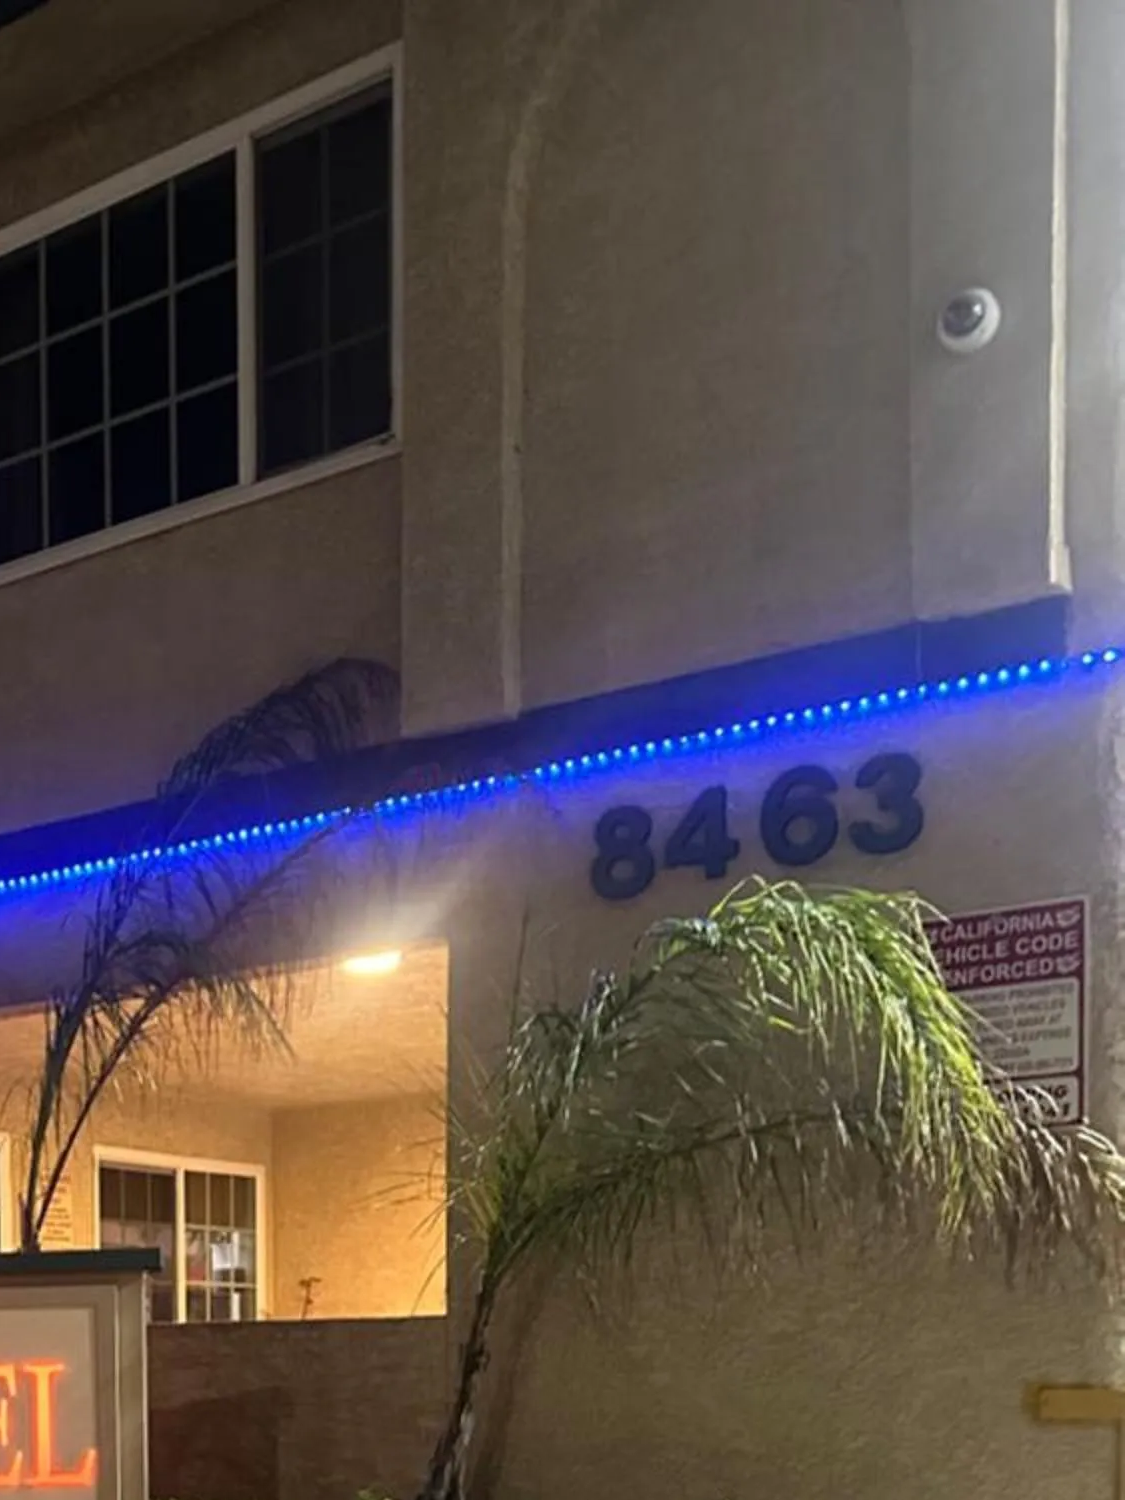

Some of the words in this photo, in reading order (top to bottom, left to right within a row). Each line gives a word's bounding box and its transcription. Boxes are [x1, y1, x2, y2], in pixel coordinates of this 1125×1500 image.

[590, 752, 924, 899] 8463
[940, 912, 1055, 944] CALIFORNIA
[1015, 929, 1079, 955] CODE
